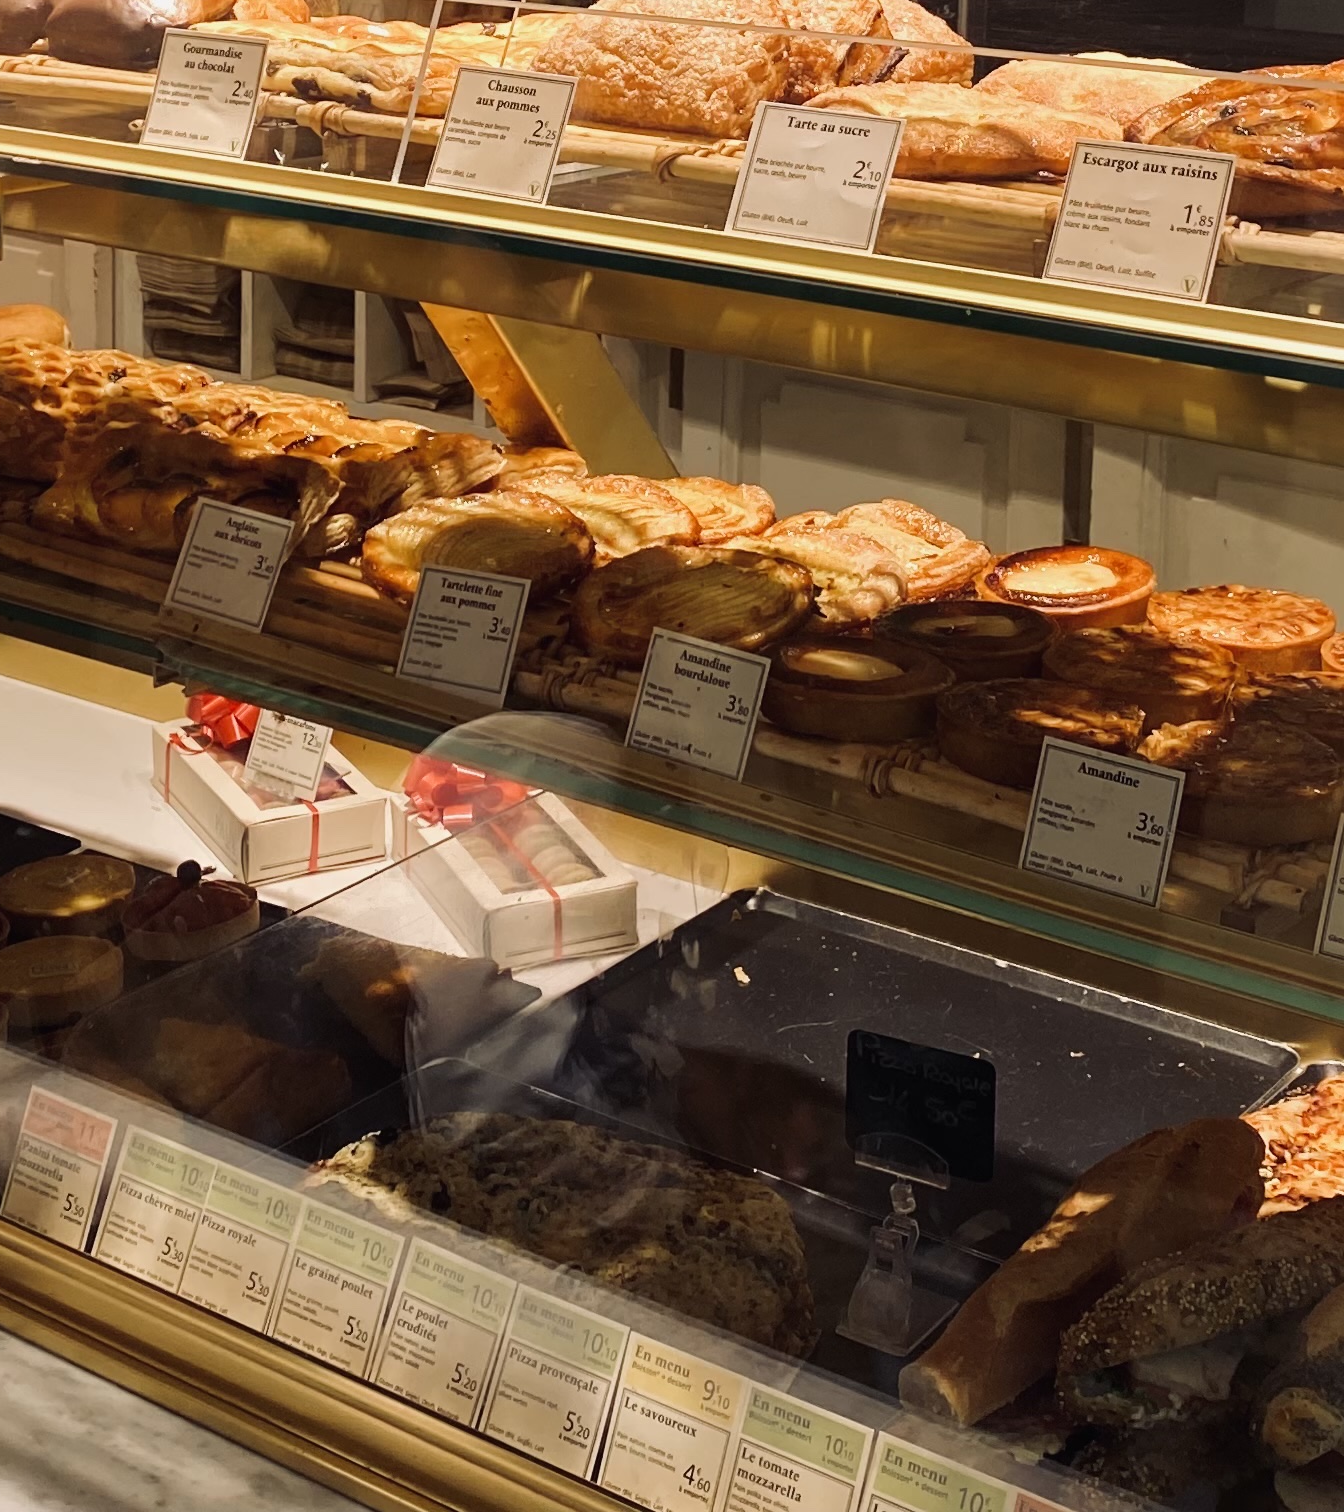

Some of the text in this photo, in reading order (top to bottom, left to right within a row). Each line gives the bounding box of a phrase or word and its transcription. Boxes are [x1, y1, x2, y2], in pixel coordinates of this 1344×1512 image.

[183, 42, 243, 59] Gourmandise
[185, 60, 235, 74] au chocolat
[488, 79, 537, 96] Chausson
[476, 97, 540, 113] aux pommes
[787, 115, 871, 137] Tarte au sucre
[1082, 152, 1218, 181] Escargot aux raisins
[1176, 227, 1210, 237] emporter
[226, 517, 260, 534] Anglaise
[215, 531, 262, 549] aux abricots
[441, 577, 503, 598] Tartelette fine
[440, 594, 496, 611] aux pommes
[680, 650, 732, 673] Amandine
[674, 663, 731, 689] bourdaloue
[1077, 762, 1140, 788] Amandine
[18, 1157, 63, 1183] mozzarella
[21, 1140, 81, 1174] Panini tomate
[119, 1181, 196, 1223] Pizza chèvre miel
[201, 1215, 257, 1248] Pizza royale
[324, 1221, 355, 1239] menu
[295, 1257, 373, 1300] Le grainé poulet
[432, 1263, 465, 1284] menu
[401, 1299, 449, 1331] Le poulet
[396, 1316, 437, 1343] crudités
[509, 1347, 538, 1369] Pizza
[539, 1362, 599, 1395] provençale
[635, 1345, 691, 1378] En menu
[624, 1396, 698, 1438] Le savoureux
[752, 1394, 811, 1430] En menu
[741, 1447, 801, 1483] Le tomate
[884, 1447, 948, 1485] En menu
[736, 1466, 802, 1503] mozzarella
